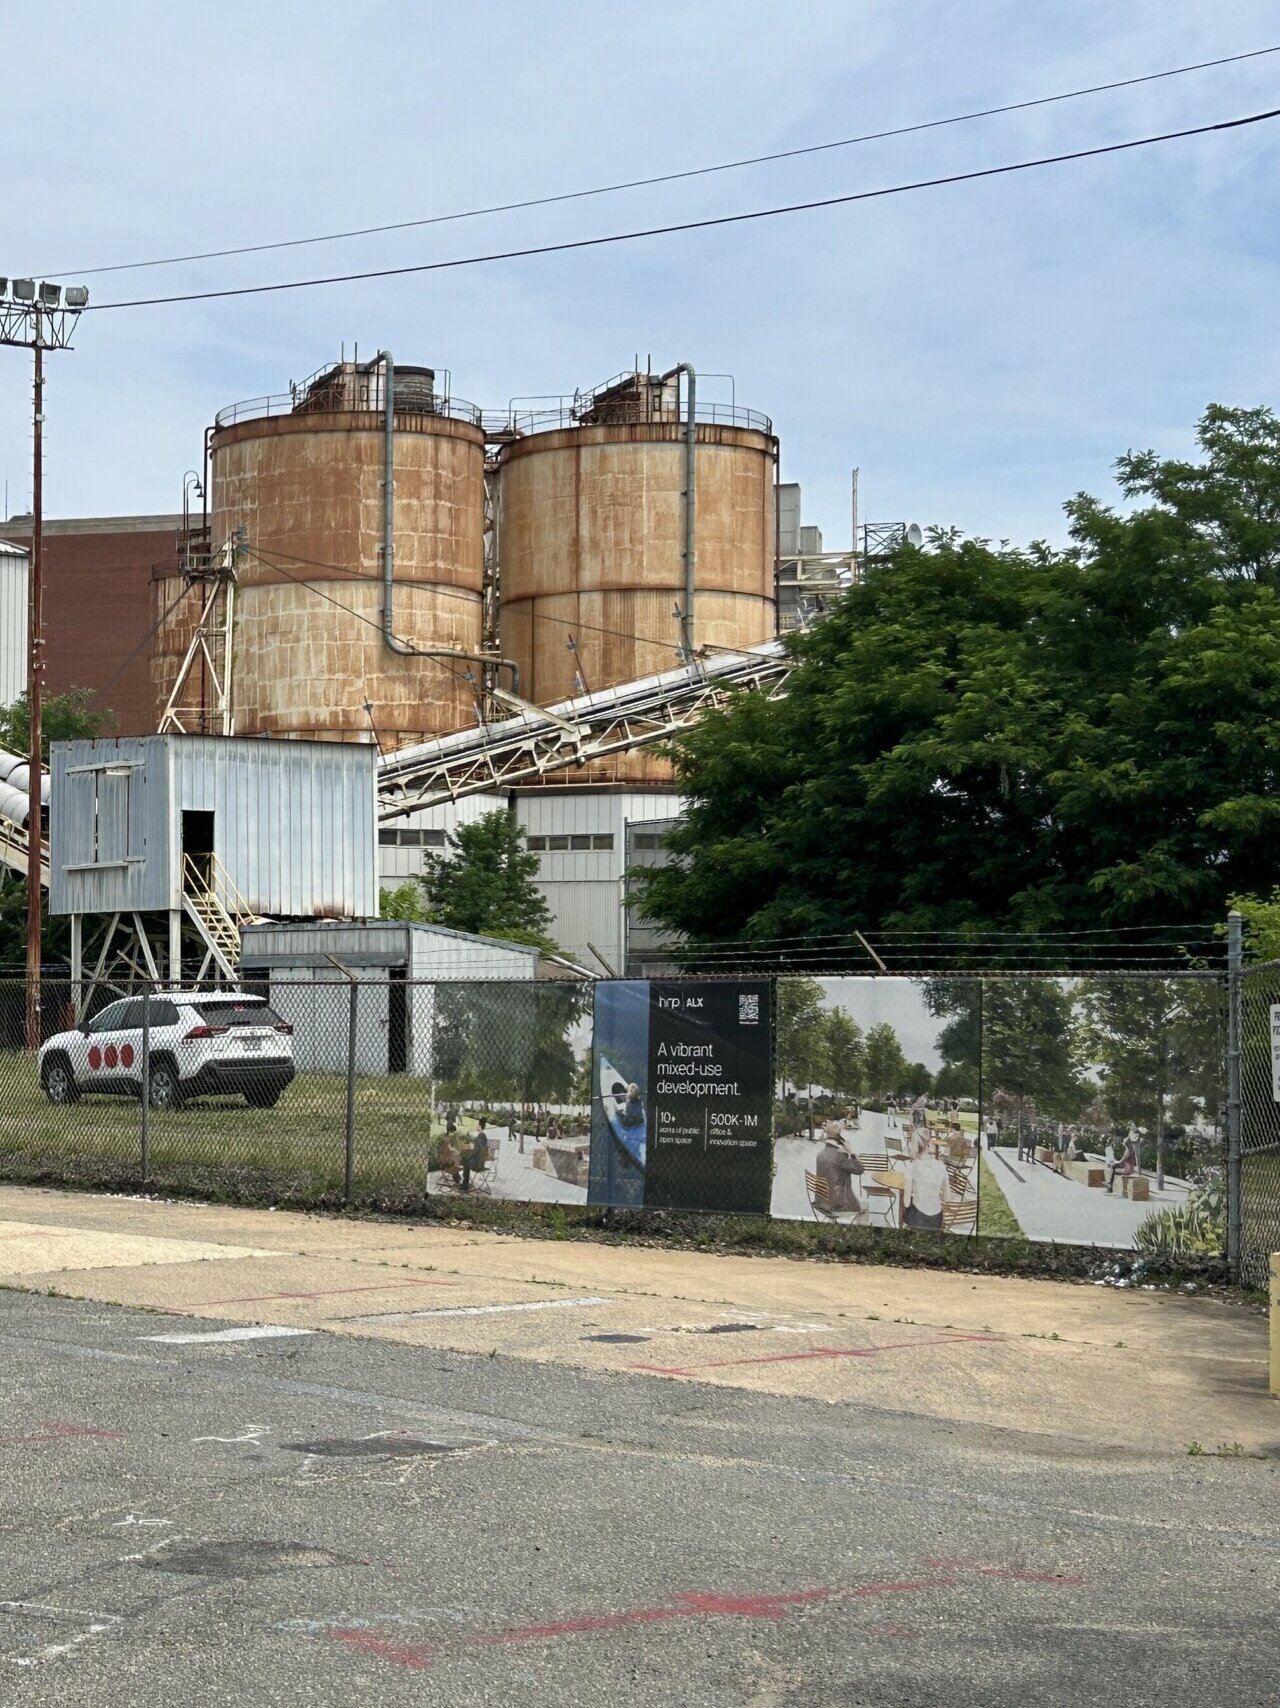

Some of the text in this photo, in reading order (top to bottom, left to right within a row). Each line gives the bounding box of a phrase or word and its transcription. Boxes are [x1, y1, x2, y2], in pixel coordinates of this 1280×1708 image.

[686, 997, 704, 1008] ALX
[657, 1042, 713, 1057] A vibrant
[657, 1060, 722, 1076] mixed-use
[656, 1079, 741, 1098] development.
[660, 1111, 676, 1124] 10+
[710, 1113, 758, 1127] 500K-1M
